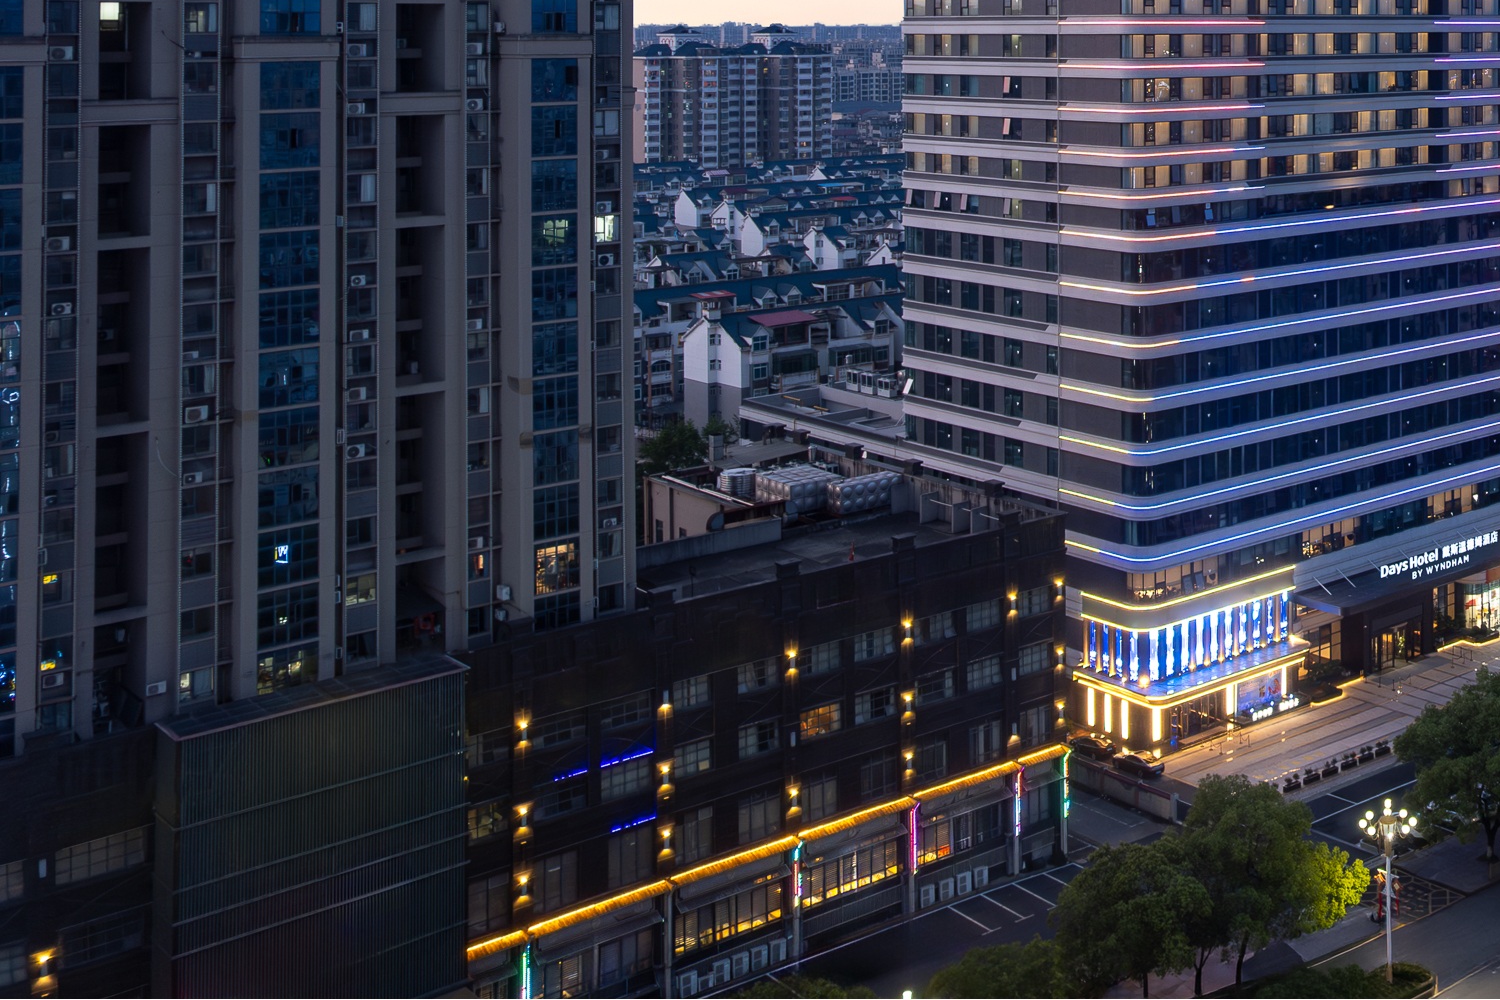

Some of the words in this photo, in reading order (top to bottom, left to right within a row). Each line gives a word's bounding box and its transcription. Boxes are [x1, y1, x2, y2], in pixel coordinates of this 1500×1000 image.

[1380, 560, 1409, 578] Days
[1409, 548, 1438, 569] Hotel
[1411, 569, 1423, 580] BY
[1426, 555, 1470, 575] WYNDHAM
